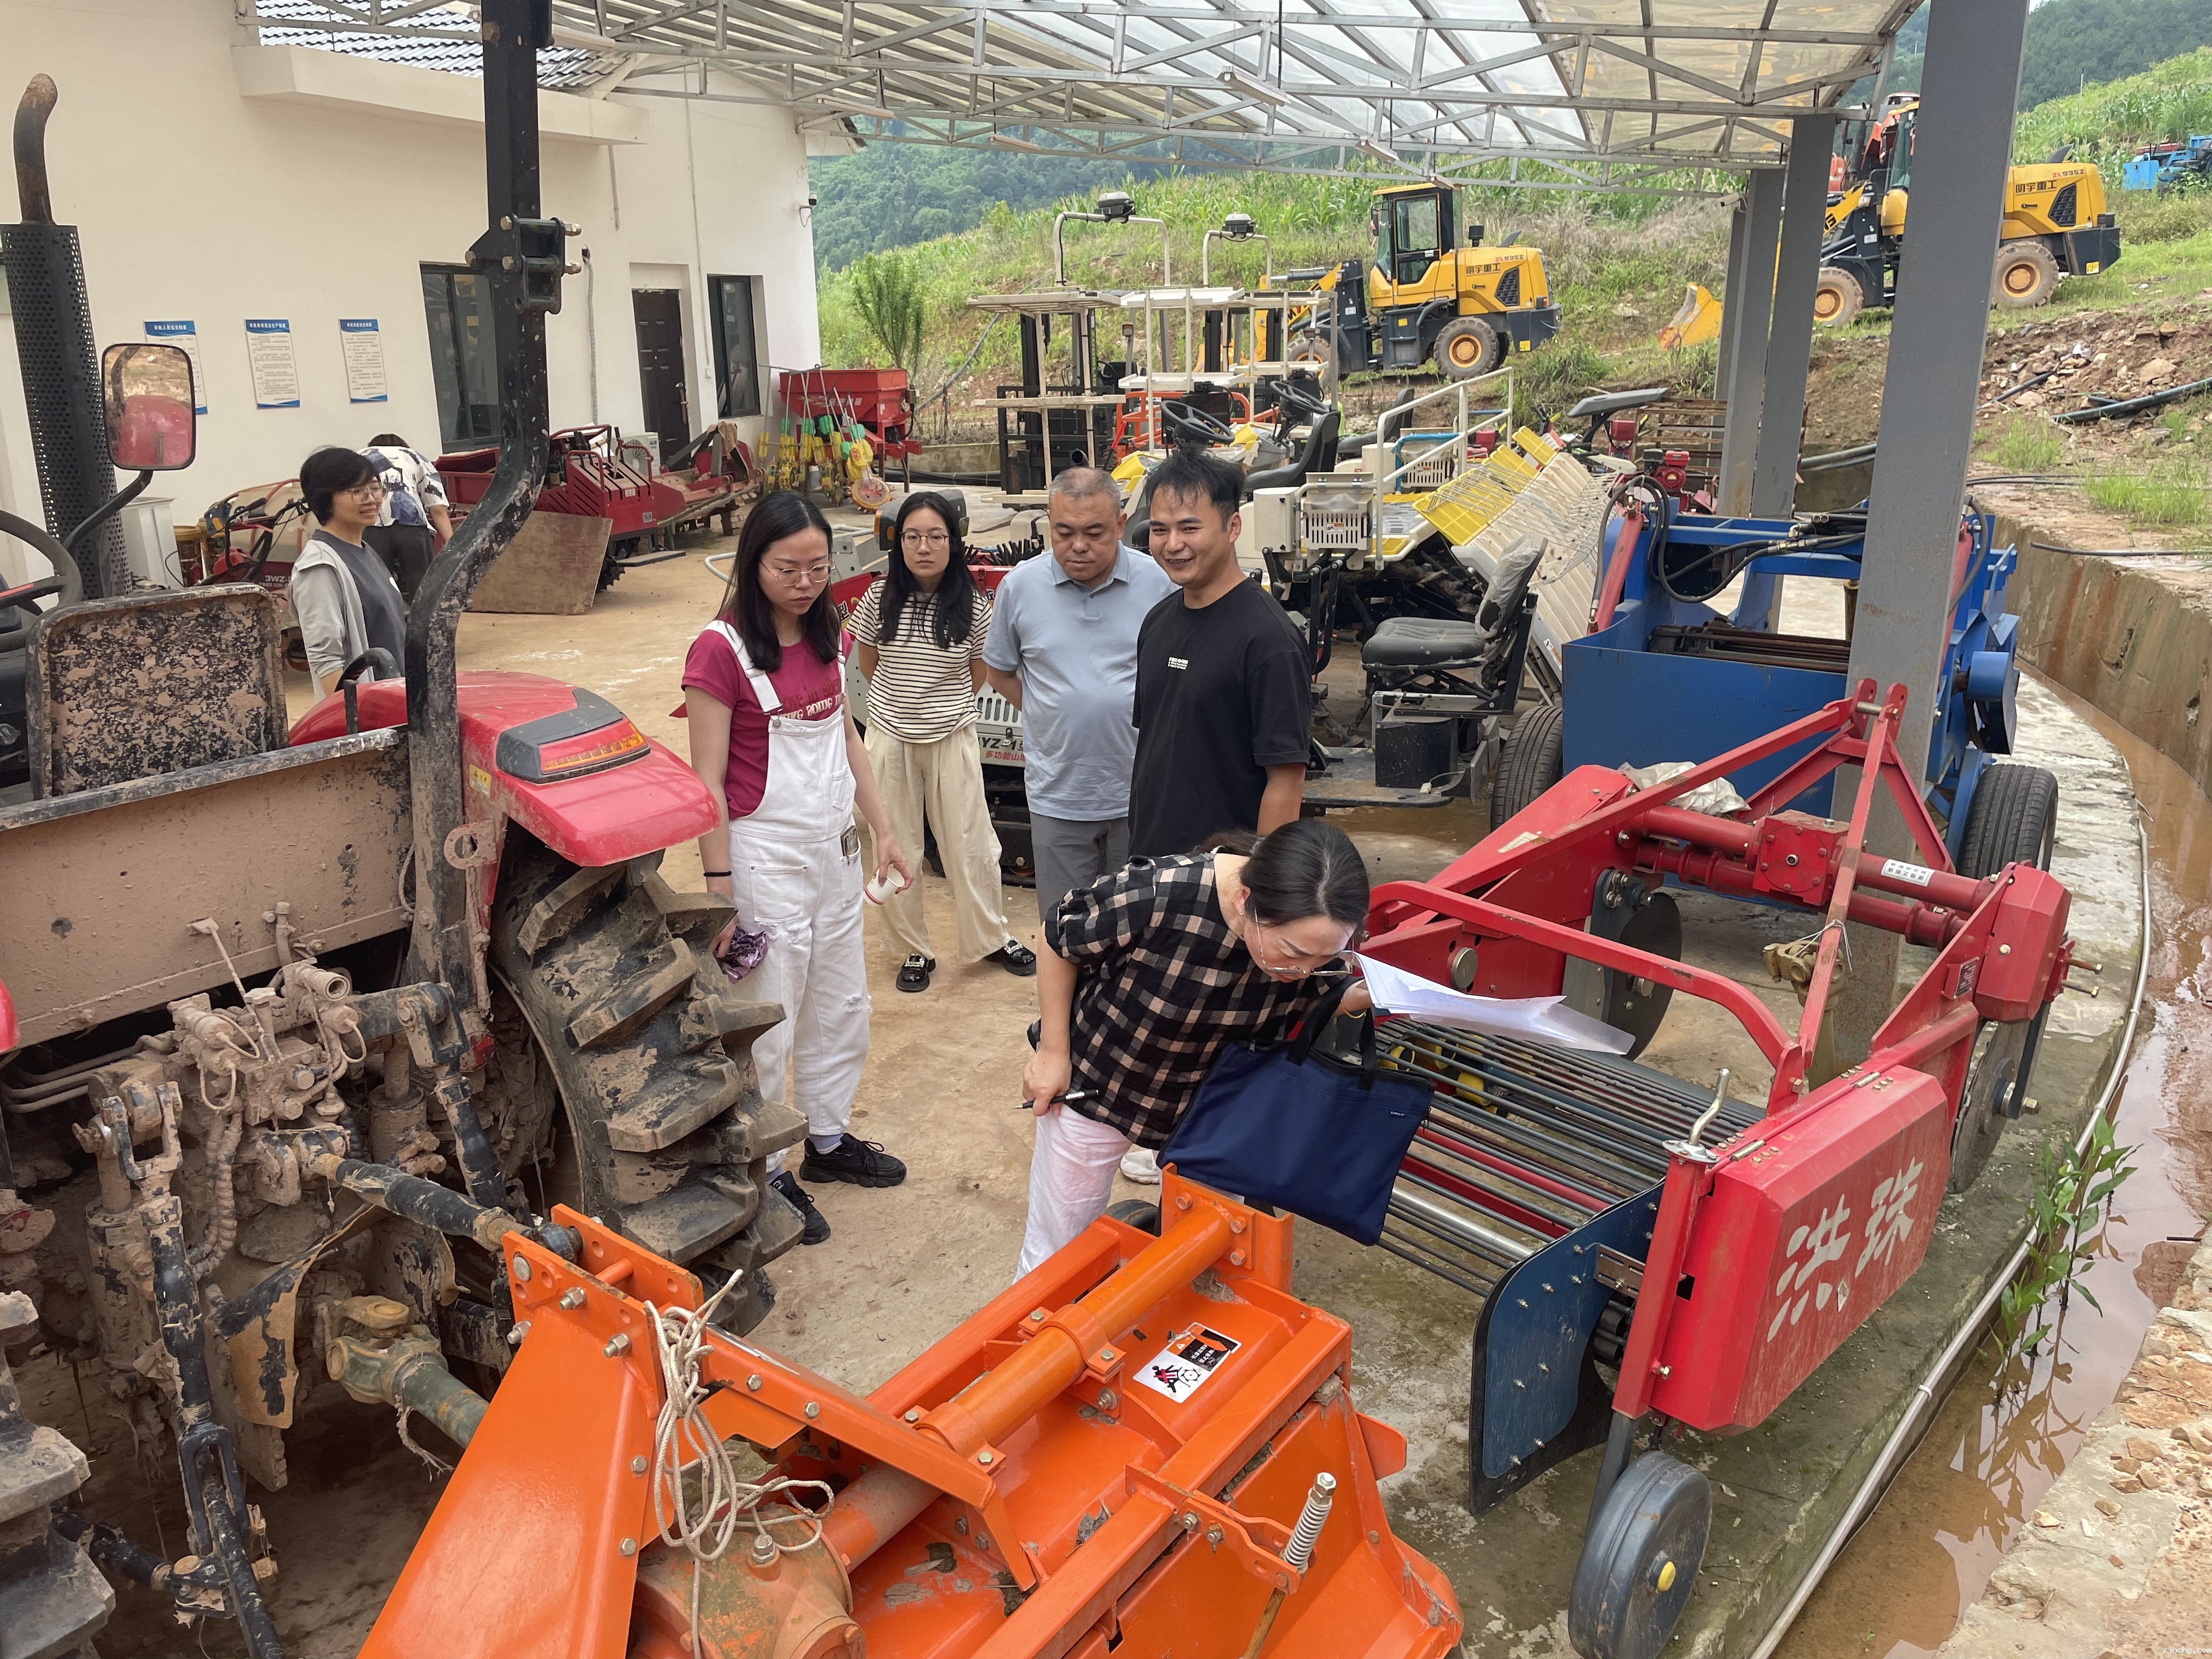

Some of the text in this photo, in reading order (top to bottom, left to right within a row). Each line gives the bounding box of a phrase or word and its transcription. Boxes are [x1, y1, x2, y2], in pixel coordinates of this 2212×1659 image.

[2015, 180, 2057, 193] 明宇重工
[1466, 263, 1501, 274] 明宇重工
[1767, 1156, 1925, 1342] 洪珠
